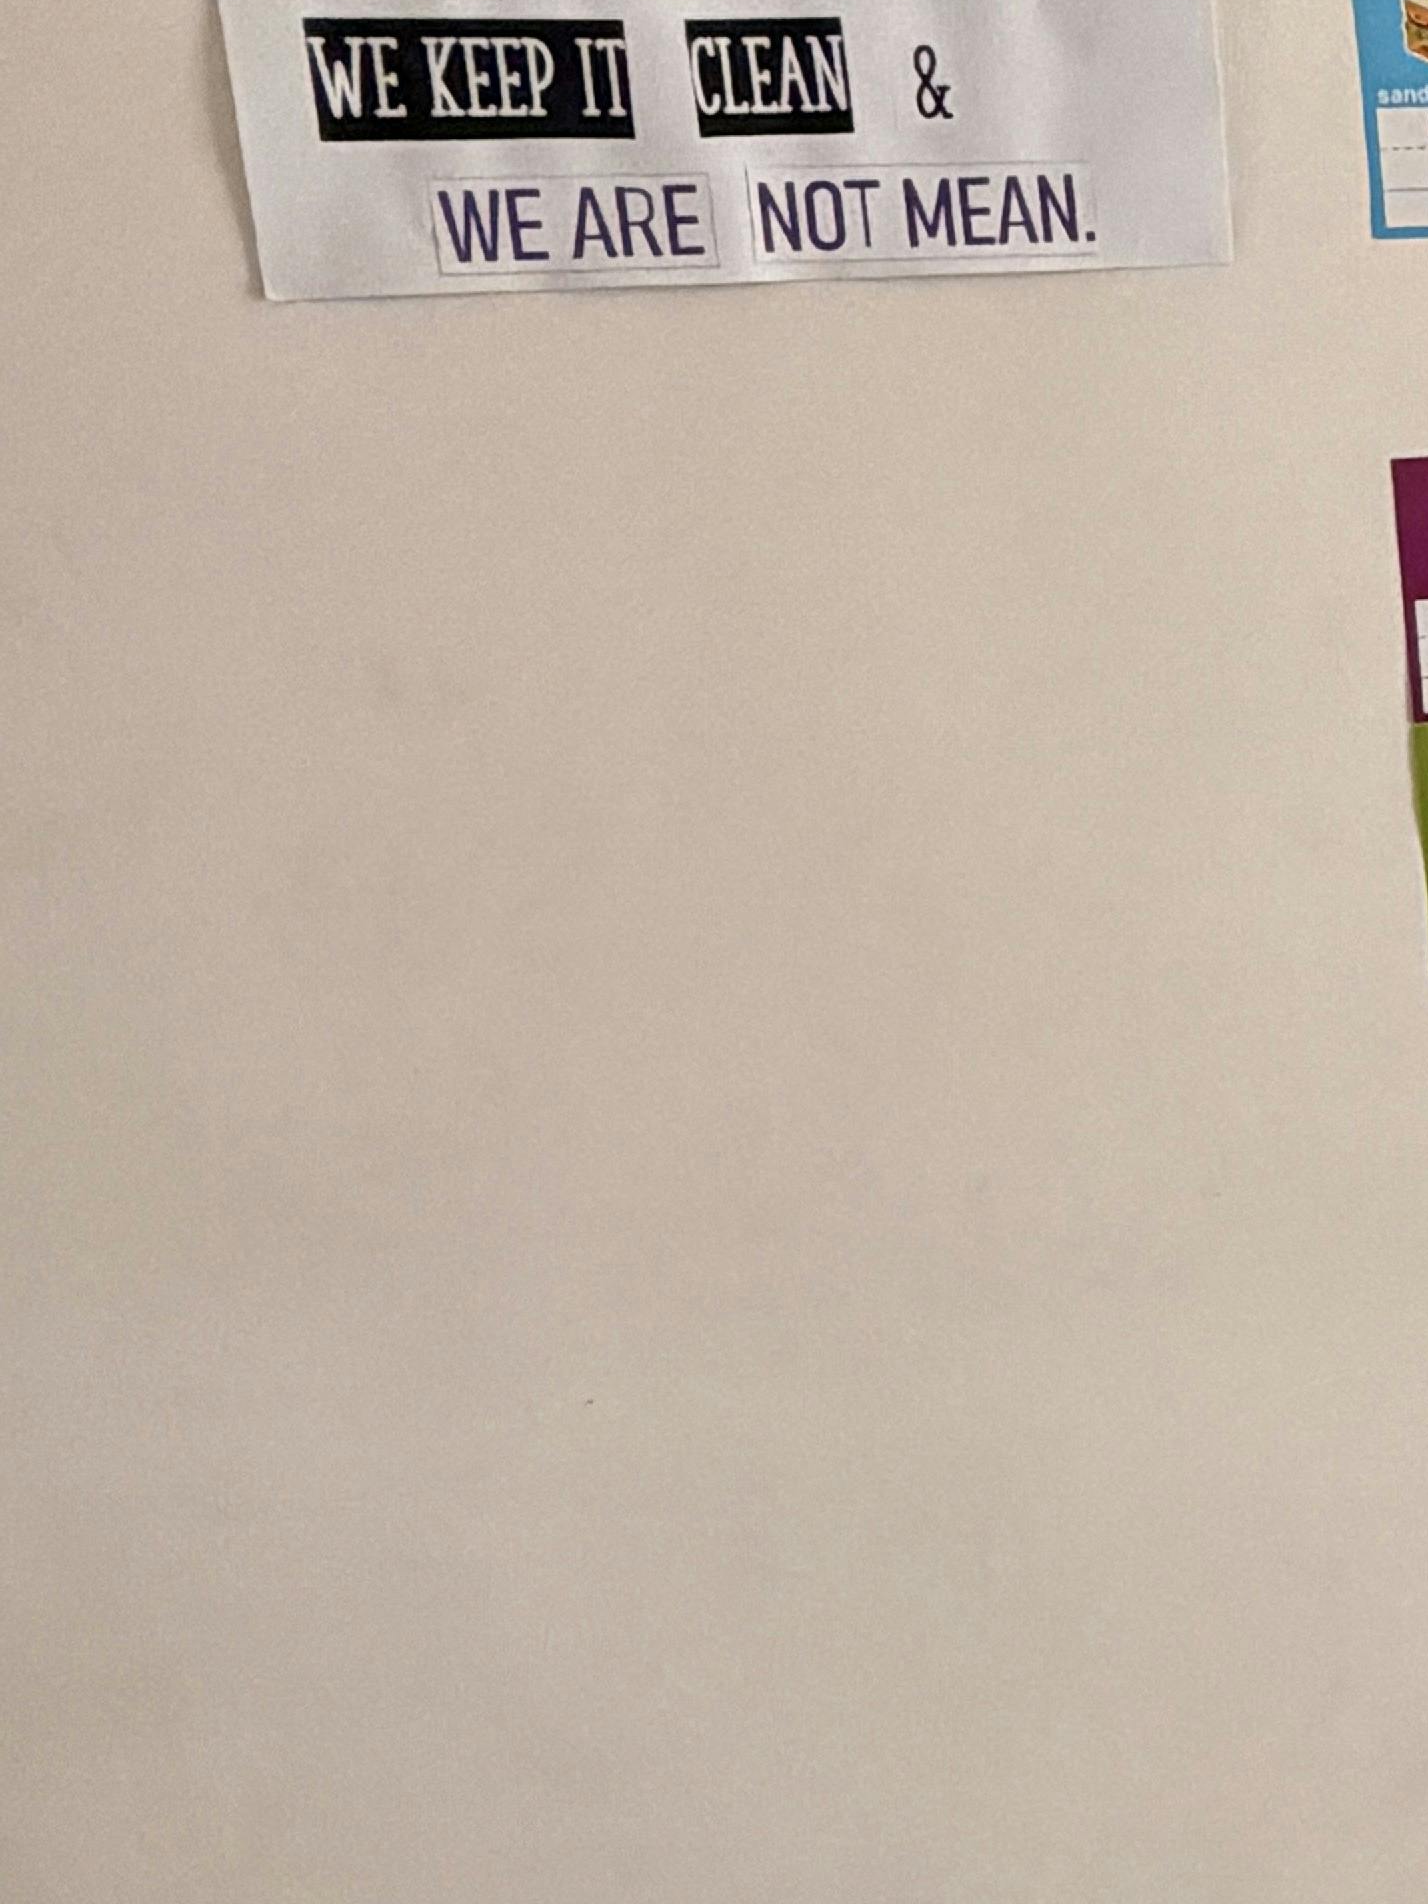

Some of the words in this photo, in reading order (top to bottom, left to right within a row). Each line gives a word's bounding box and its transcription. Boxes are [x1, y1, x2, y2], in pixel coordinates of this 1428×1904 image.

[311, 35, 404, 120] WE
[424, 35, 555, 118] KEEP
[579, 35, 626, 118] IT
[689, 35, 848, 114] CLEAN
[914, 46, 954, 120] &
[437, 190, 549, 264] WE
[574, 184, 705, 257] ARE
[759, 180, 880, 252] NOT
[907, 174, 1097, 248] MEAN.
